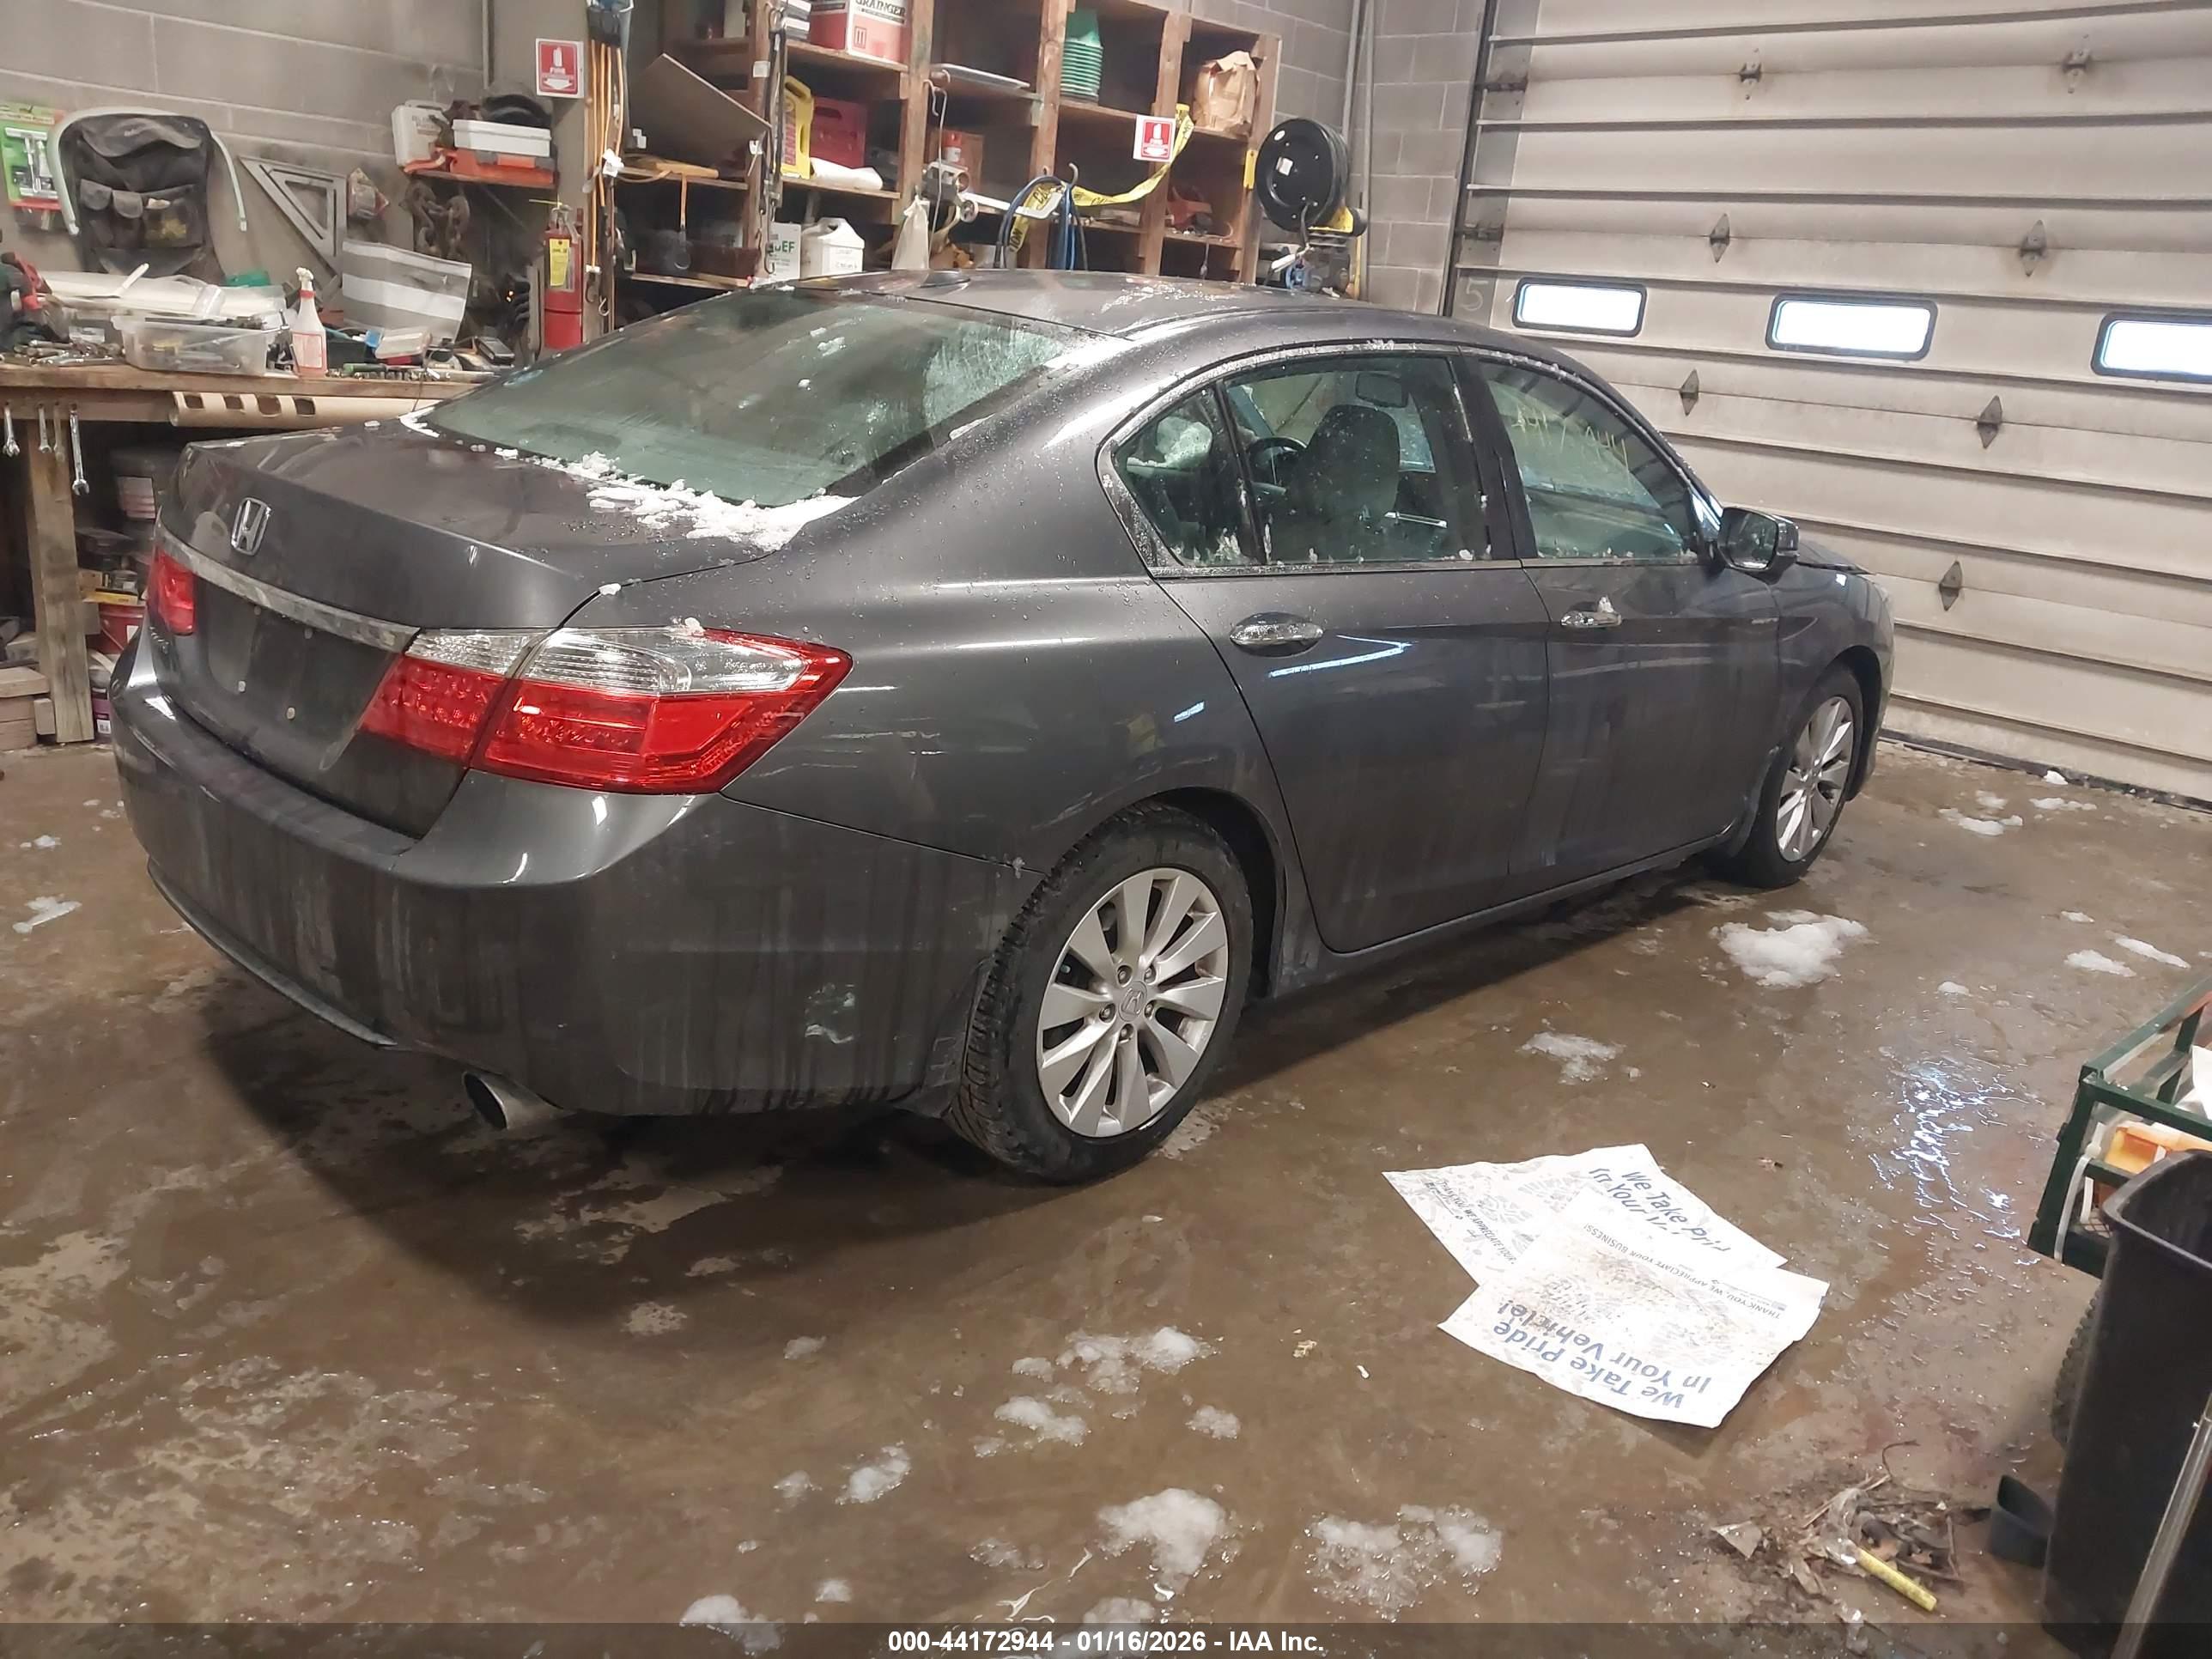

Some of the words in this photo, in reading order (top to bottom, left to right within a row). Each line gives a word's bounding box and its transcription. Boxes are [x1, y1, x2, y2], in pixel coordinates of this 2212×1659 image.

[1460, 276, 1488, 312] 5
[1589, 1168, 1613, 1183] In
[1607, 1183, 1648, 1213] Your
[1621, 1171, 1652, 1190] We
[1646, 1192, 1688, 1224] Take
[1583, 1224, 1629, 1254] BUSINESS!
[1656, 1261, 1708, 1287] APPRECIATE
[1710, 1285, 1723, 1296] WE
[1748, 1302, 1781, 1320] THANK
[1492, 1321, 1565, 1363] Pride
[1498, 1300, 1605, 1361] Vehicle!
[1570, 1356, 1632, 1395] Take
[1609, 1351, 1672, 1387] Your
[1682, 1375, 1712, 1395] In
[1641, 1385, 1685, 1409] We
